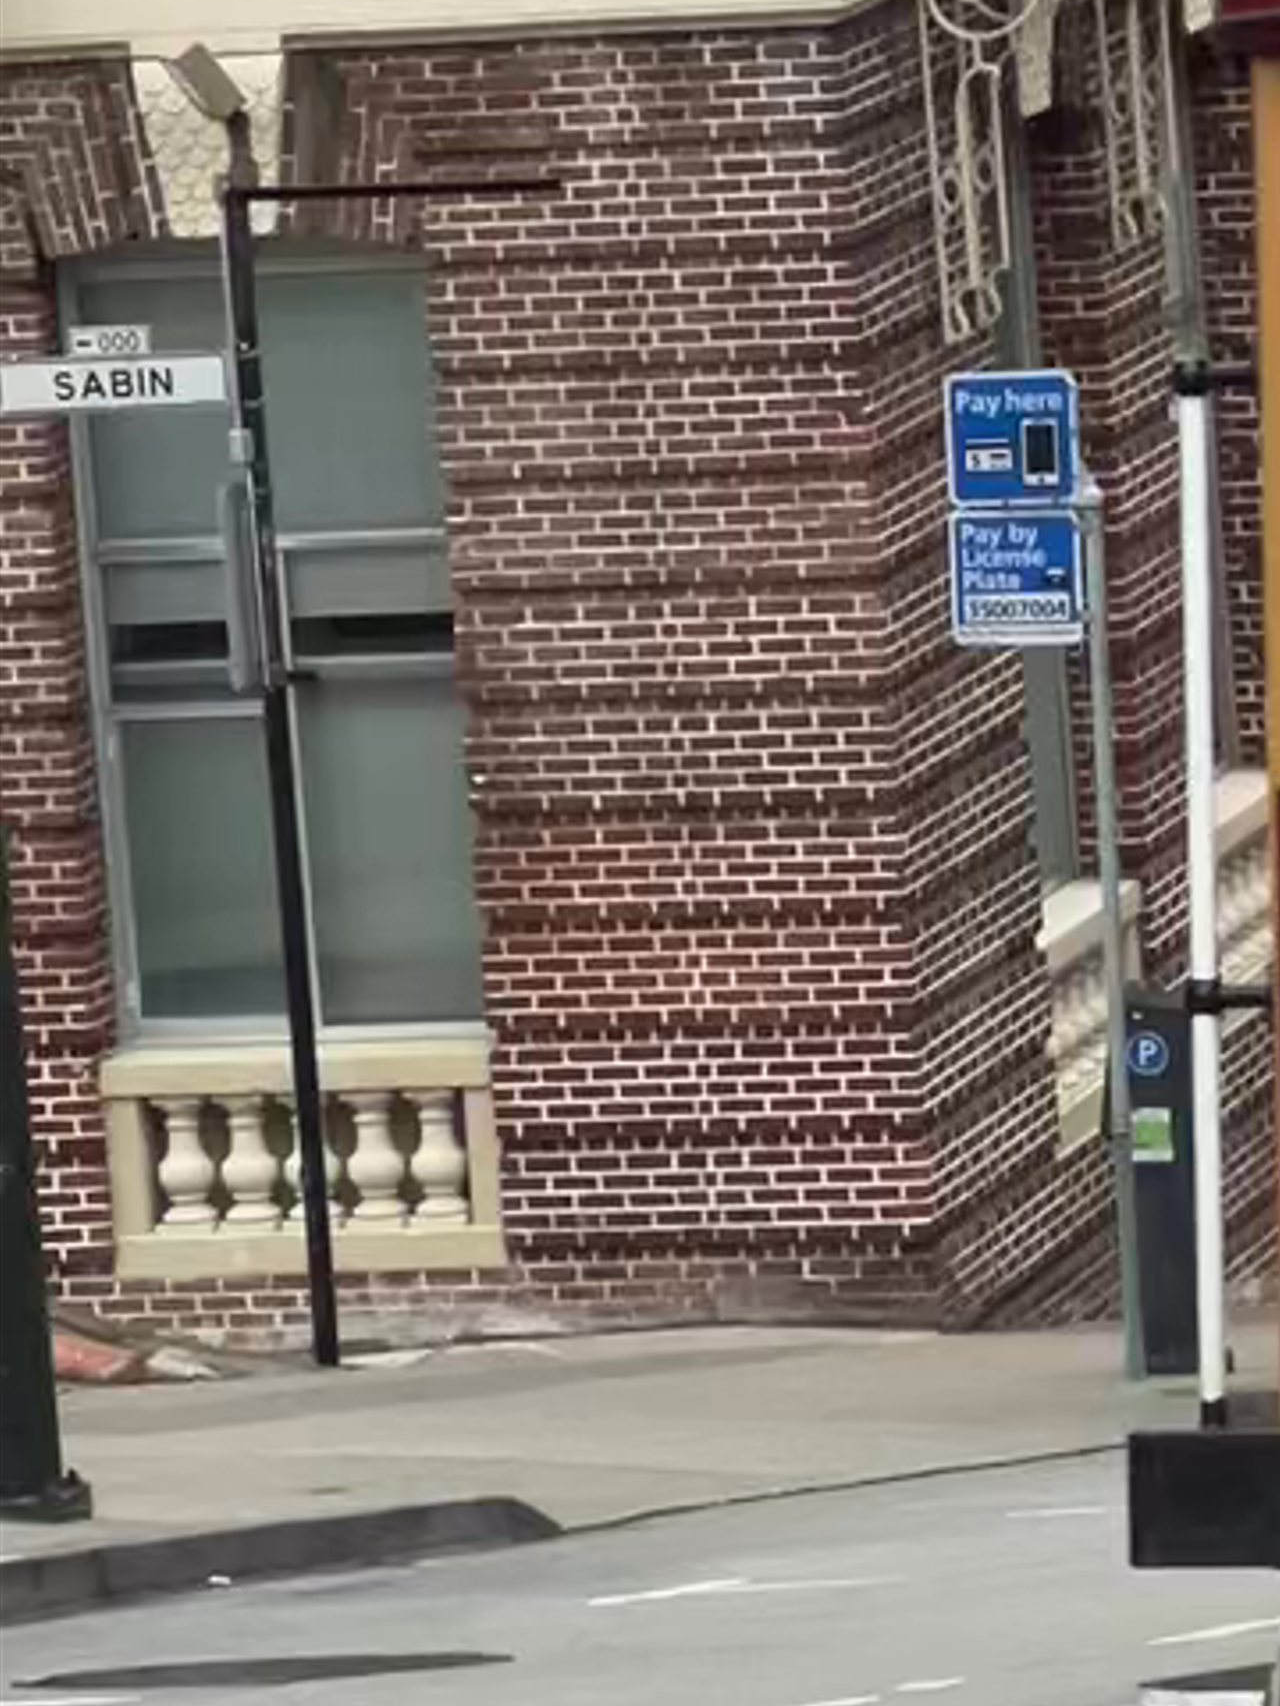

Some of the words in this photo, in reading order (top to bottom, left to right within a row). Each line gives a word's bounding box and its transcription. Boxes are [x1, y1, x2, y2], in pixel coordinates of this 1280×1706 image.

[53, 367, 174, 401] SABIN
[954, 389, 1002, 418] Pay
[1004, 386, 1063, 413] here
[961, 523, 1002, 548] Pay
[1007, 523, 1038, 546] by
[961, 548, 1047, 568] License
[961, 569, 1022, 590] Plate
